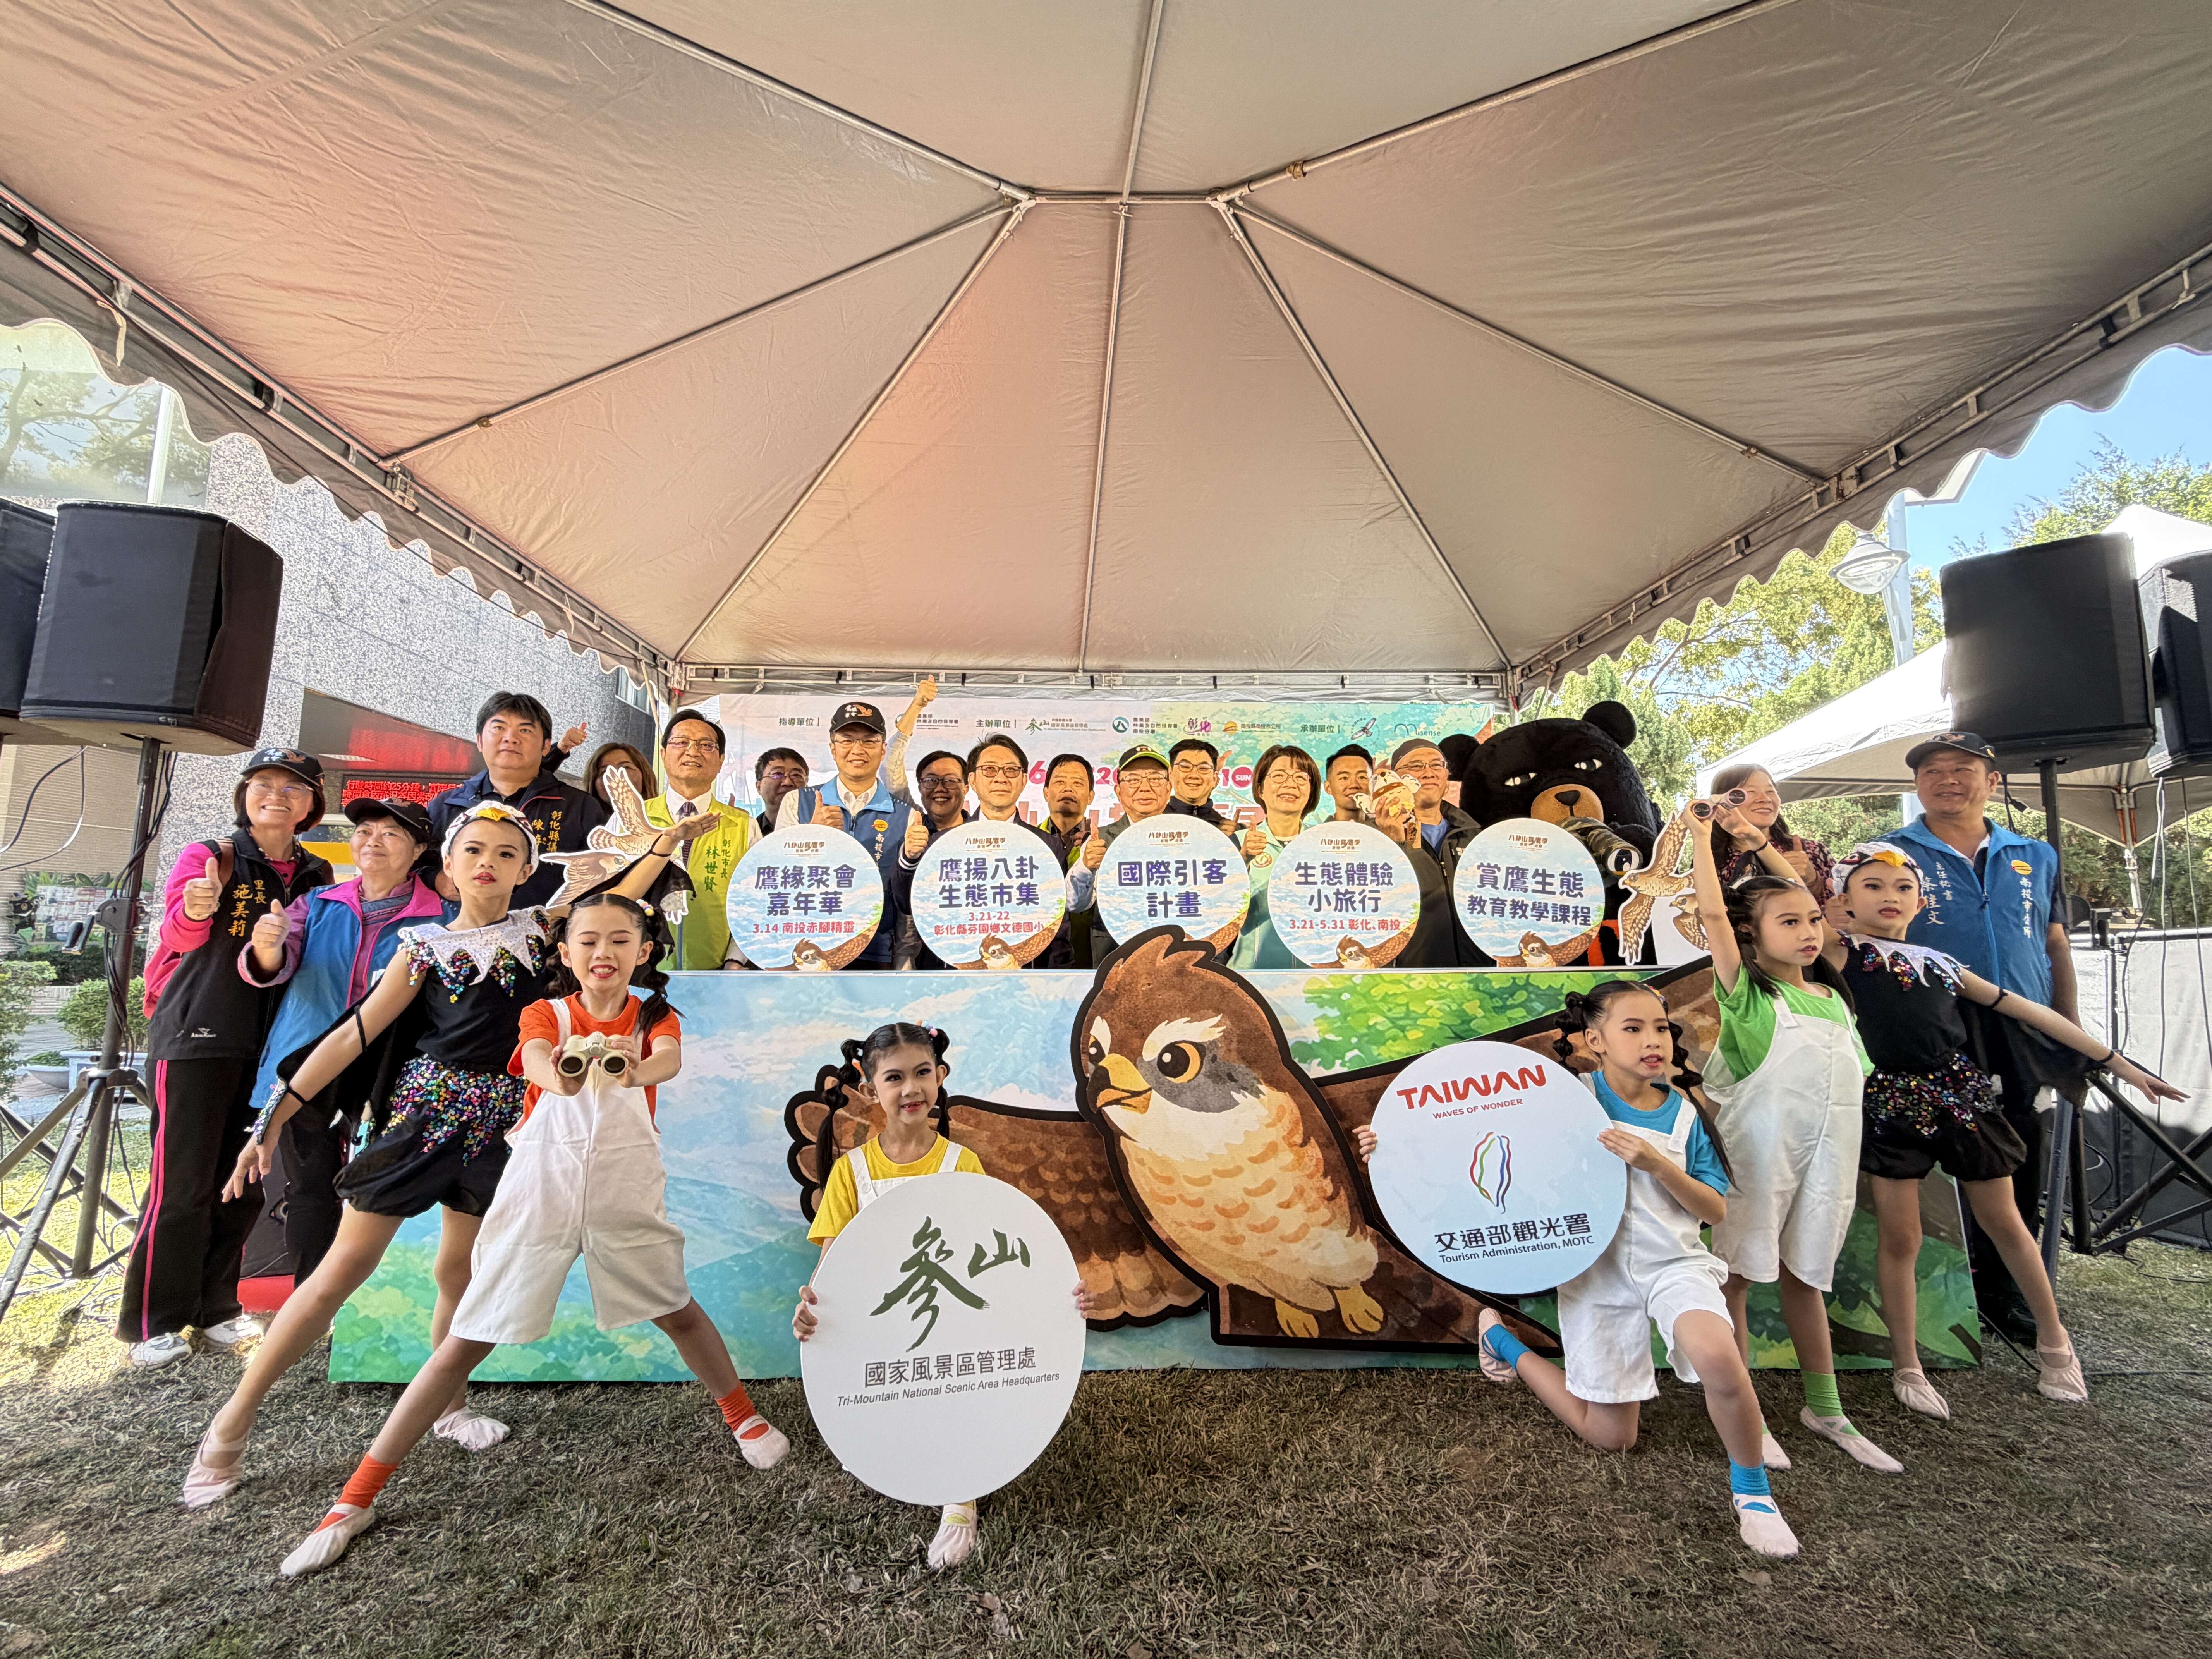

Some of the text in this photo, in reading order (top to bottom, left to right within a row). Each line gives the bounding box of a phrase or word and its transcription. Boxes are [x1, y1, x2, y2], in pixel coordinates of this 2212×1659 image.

[779, 717, 814, 726] 指導單位
[975, 719, 1011, 728] 主辦單位
[1300, 724, 1334, 733] 承辦單位
[720, 838, 731, 879] 彰化市長
[874, 833, 884, 867] 南投市
[704, 845, 721, 893] 林世賢
[754, 864, 857, 890] 鷹緣聚會
[939, 855, 1039, 882] 鷹揚八卦
[1117, 858, 1227, 887] 國際引客
[1294, 861, 1393, 886] 生態體驗
[1476, 862, 1584, 898] 賞鷹生態
[253, 879, 267, 904] 里長
[766, 890, 843, 917] 嘉年華
[939, 882, 1040, 908] 生態市集
[1146, 891, 1202, 919] 計畫
[1308, 888, 1382, 913] 小旅行
[969, 911, 1010, 921] 3.21-22
[1467, 895, 1592, 927] 教育教學課程
[2020, 876, 2034, 938] 南投市公所
[752, 921, 855, 934] 3.14 南投赤腳精靈
[934, 921, 1044, 936] 彰化縣芬園鄉文德國小
[1289, 919, 1401, 931] 3.21-5.31 彰化、南投
[1396, 1064, 1547, 1110] TAIWAN
[1433, 1108, 1465, 1120] WAVES
[1480, 1098, 1523, 1111] WONDER
[1434, 1212, 1591, 1253] 交通部觀光署
[1439, 1235, 1594, 1264] Tourism Administration, MOTC
[869, 1216, 1031, 1353] 參山
[864, 1346, 1036, 1388] 國家風景區管理處
[837, 1372, 1060, 1407] Tri-Mountain National Scenic Area Headquarters
